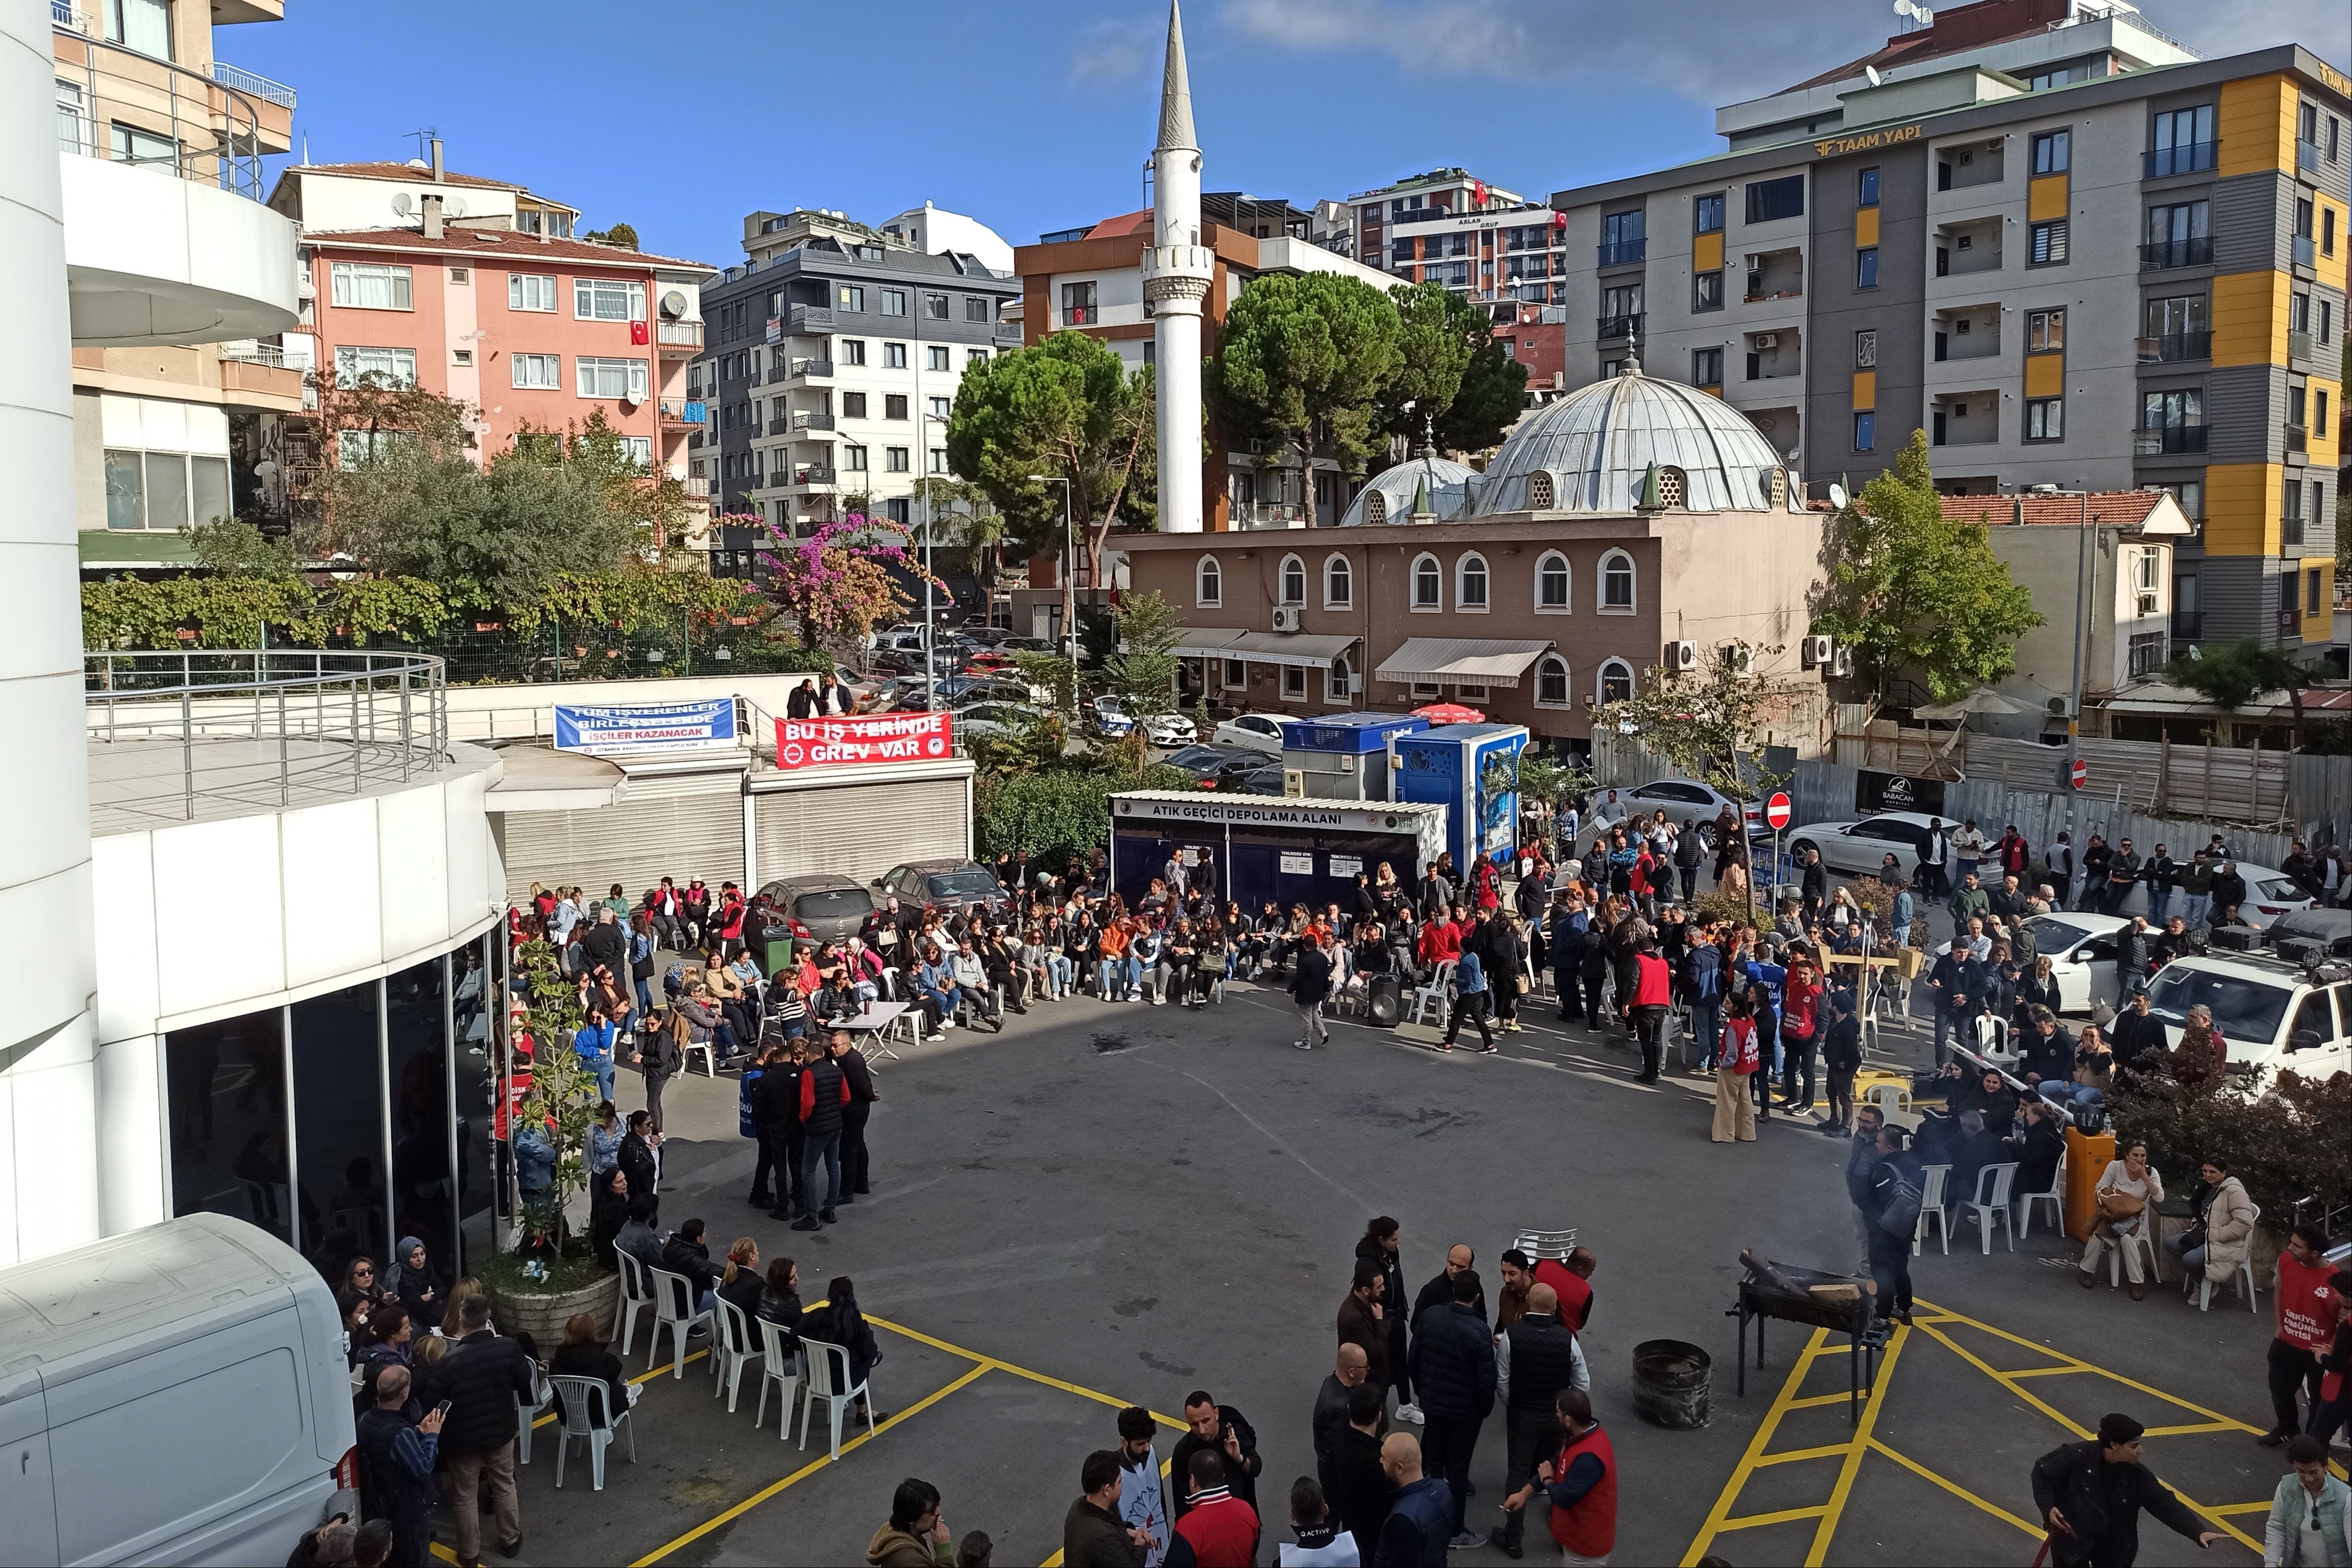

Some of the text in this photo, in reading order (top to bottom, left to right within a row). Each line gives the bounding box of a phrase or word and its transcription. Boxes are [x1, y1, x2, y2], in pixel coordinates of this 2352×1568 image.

[1836, 125, 1922, 153] TAAM YAPI
[589, 728, 703, 742] İŞÇİLER KAZANACAK
[785, 716, 943, 743] BU İŞ YERİNDE
[810, 743, 870, 762] GREV
[877, 740, 920, 758] VAR
[1883, 791, 1914, 803] BABACAN
[1152, 805, 1342, 824] ATIK GEÇİCİ DEPOLAMA ALANI
[511, 1085, 527, 1094] DİSK
